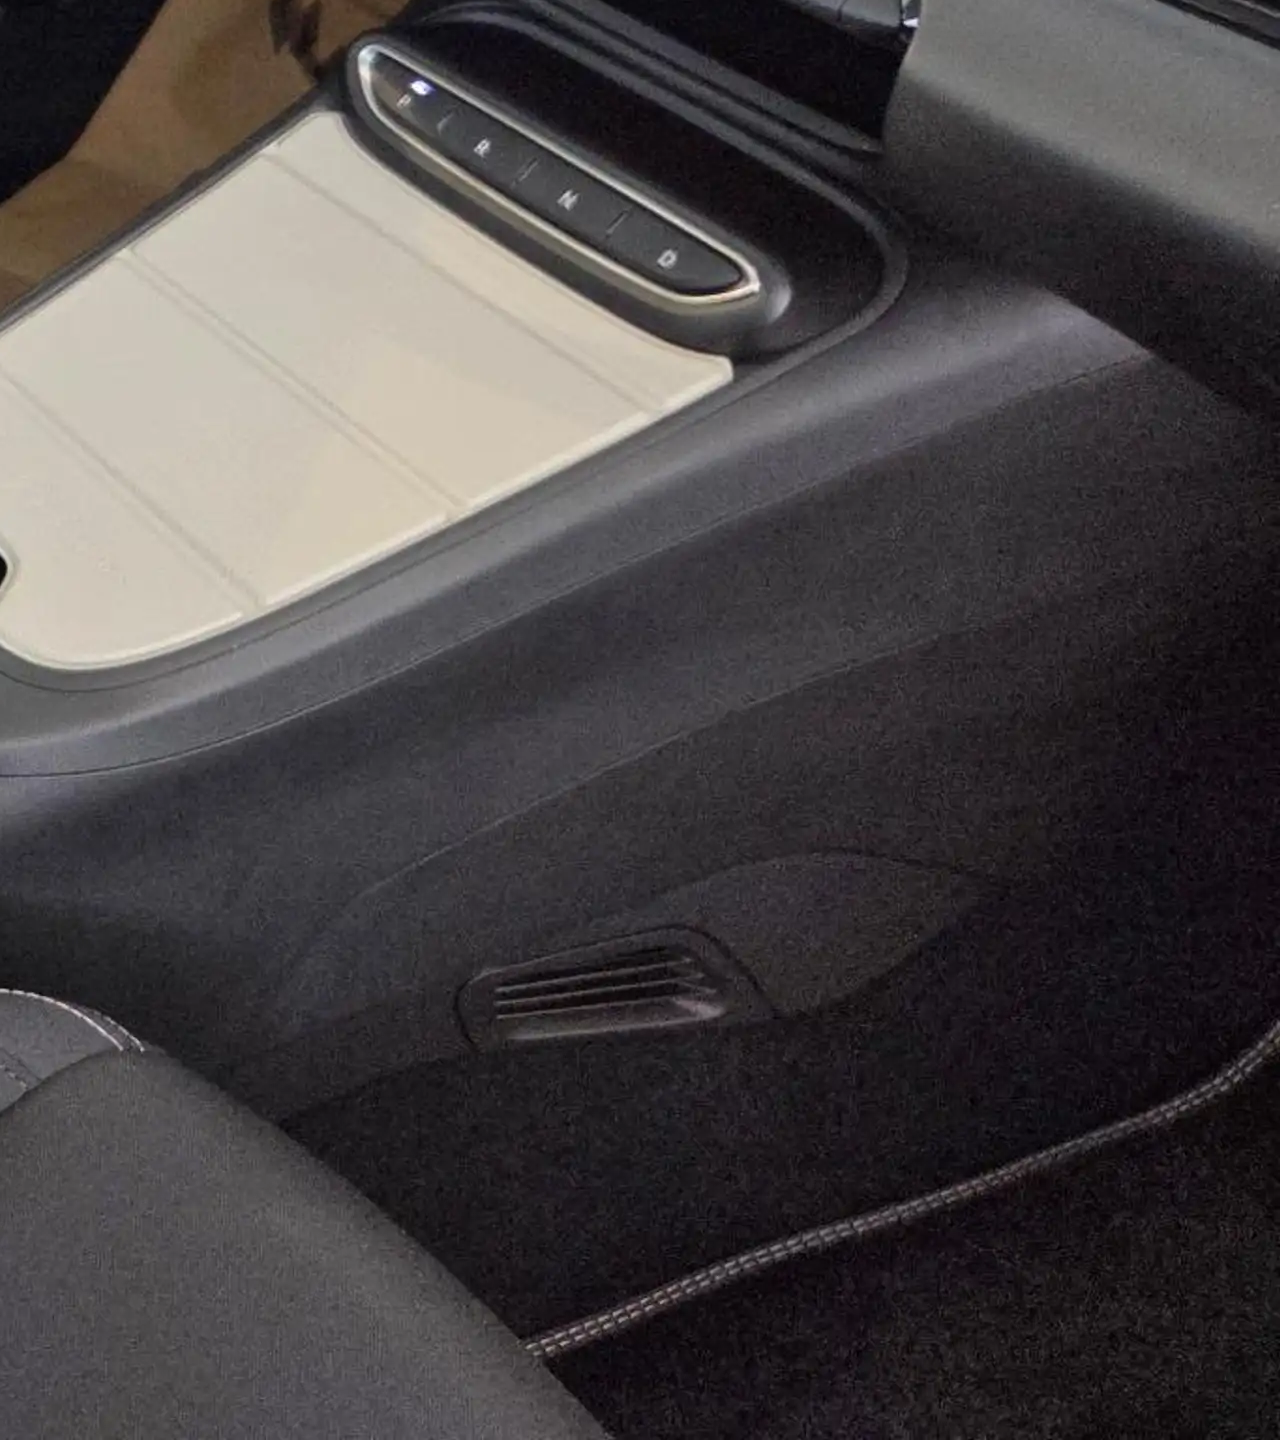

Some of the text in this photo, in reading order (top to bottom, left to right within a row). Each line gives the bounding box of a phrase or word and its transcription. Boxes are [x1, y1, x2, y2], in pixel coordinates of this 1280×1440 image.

[473, 137, 491, 158] R
[557, 189, 580, 212] N
[656, 249, 678, 269] D
